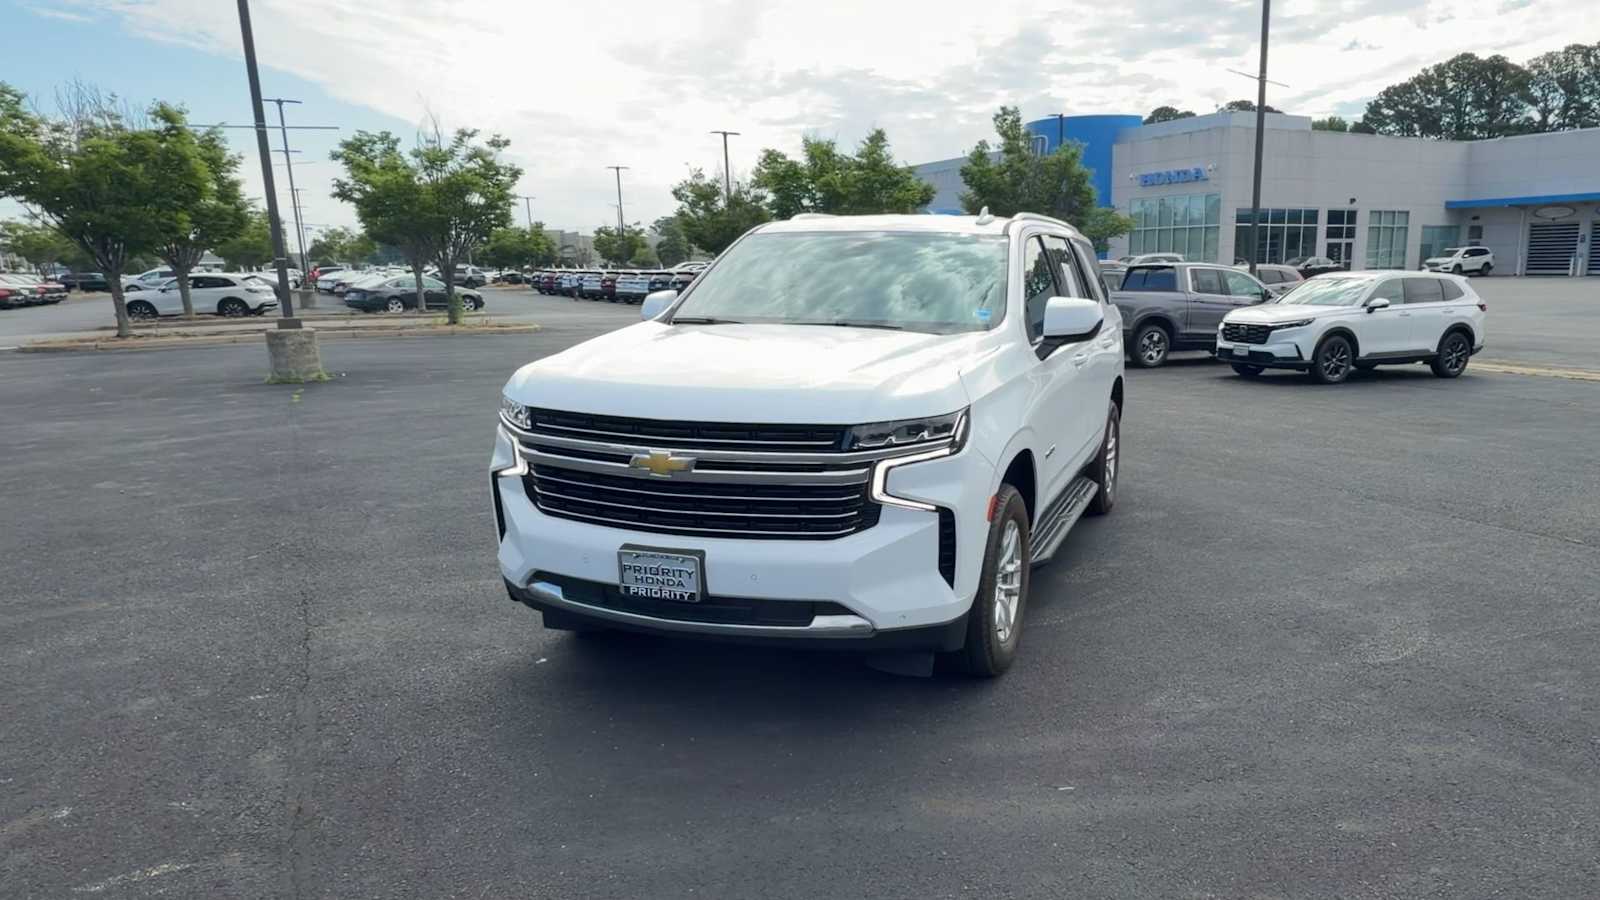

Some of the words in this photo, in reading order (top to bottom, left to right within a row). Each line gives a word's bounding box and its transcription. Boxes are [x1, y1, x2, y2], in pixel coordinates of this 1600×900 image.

[1140, 167, 1208, 186] HONDA
[623, 564, 694, 578] PRIORITY
[634, 575, 685, 587] HONDA
[630, 587, 690, 600] PRIORITY
